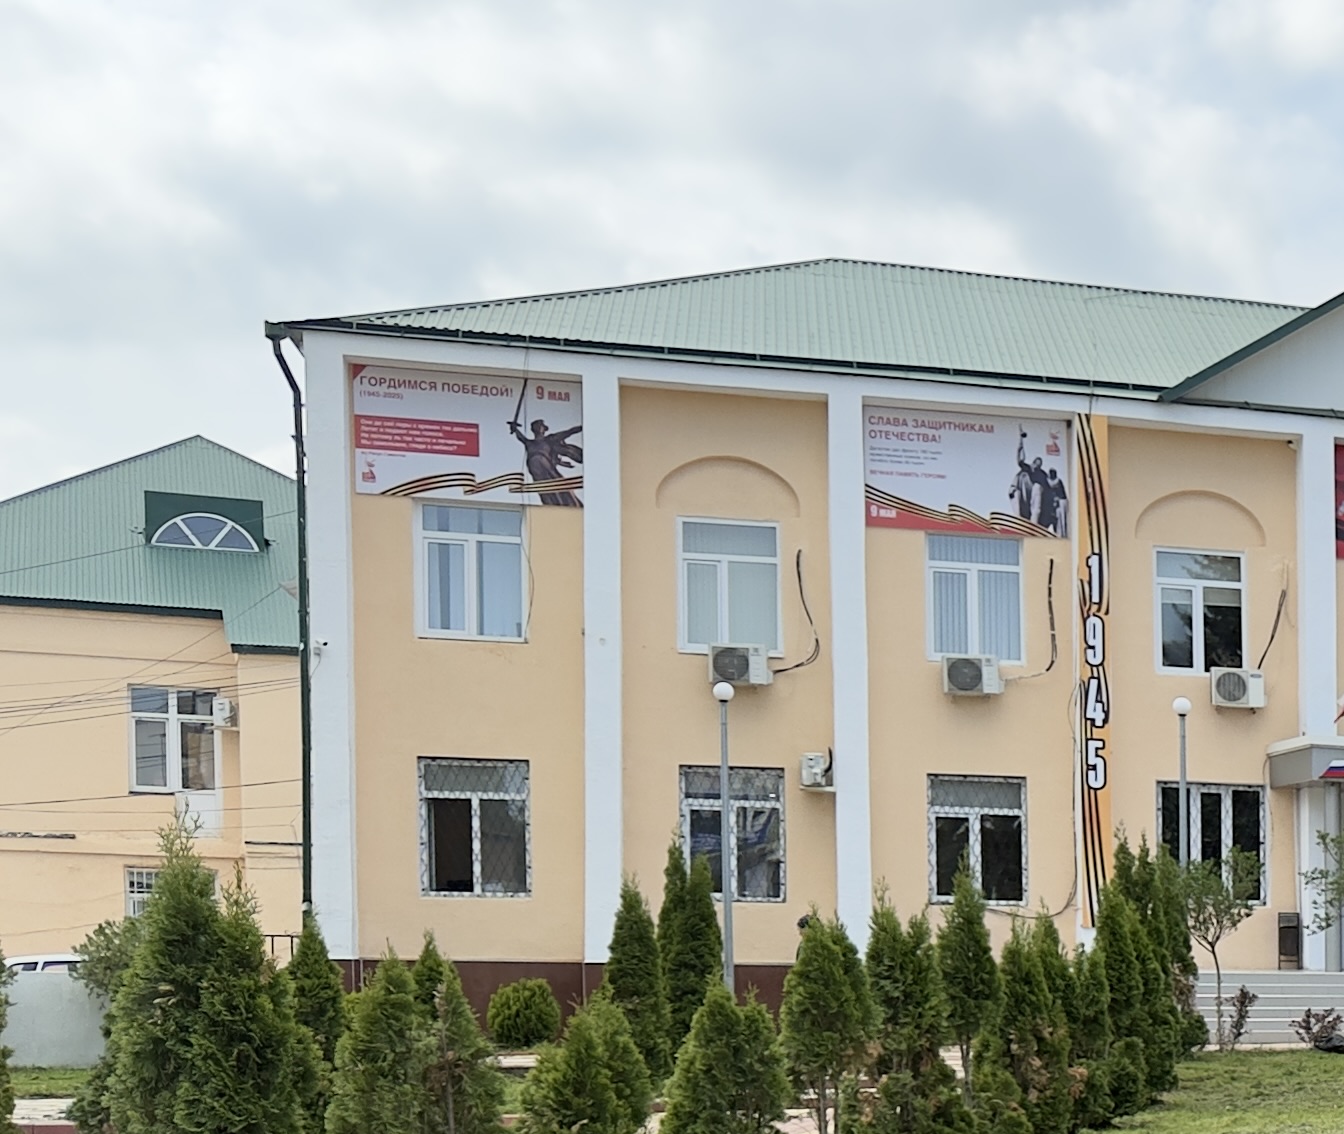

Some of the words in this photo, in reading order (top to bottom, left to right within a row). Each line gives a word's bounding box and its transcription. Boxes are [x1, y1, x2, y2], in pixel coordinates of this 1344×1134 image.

[360, 375, 437, 392] ГОРДИМСЯ
[441, 381, 513, 398] ПОБЕДОЙ!
[535, 385, 545, 400] 9
[868, 415, 908, 428] СЛАВА
[911, 418, 994, 434] ЗАЩИТНИКАМ
[868, 429, 941, 444] ОТЕЧЕСТВА!
[870, 504, 878, 518] 9
[1084, 552, 1107, 791] 1945
